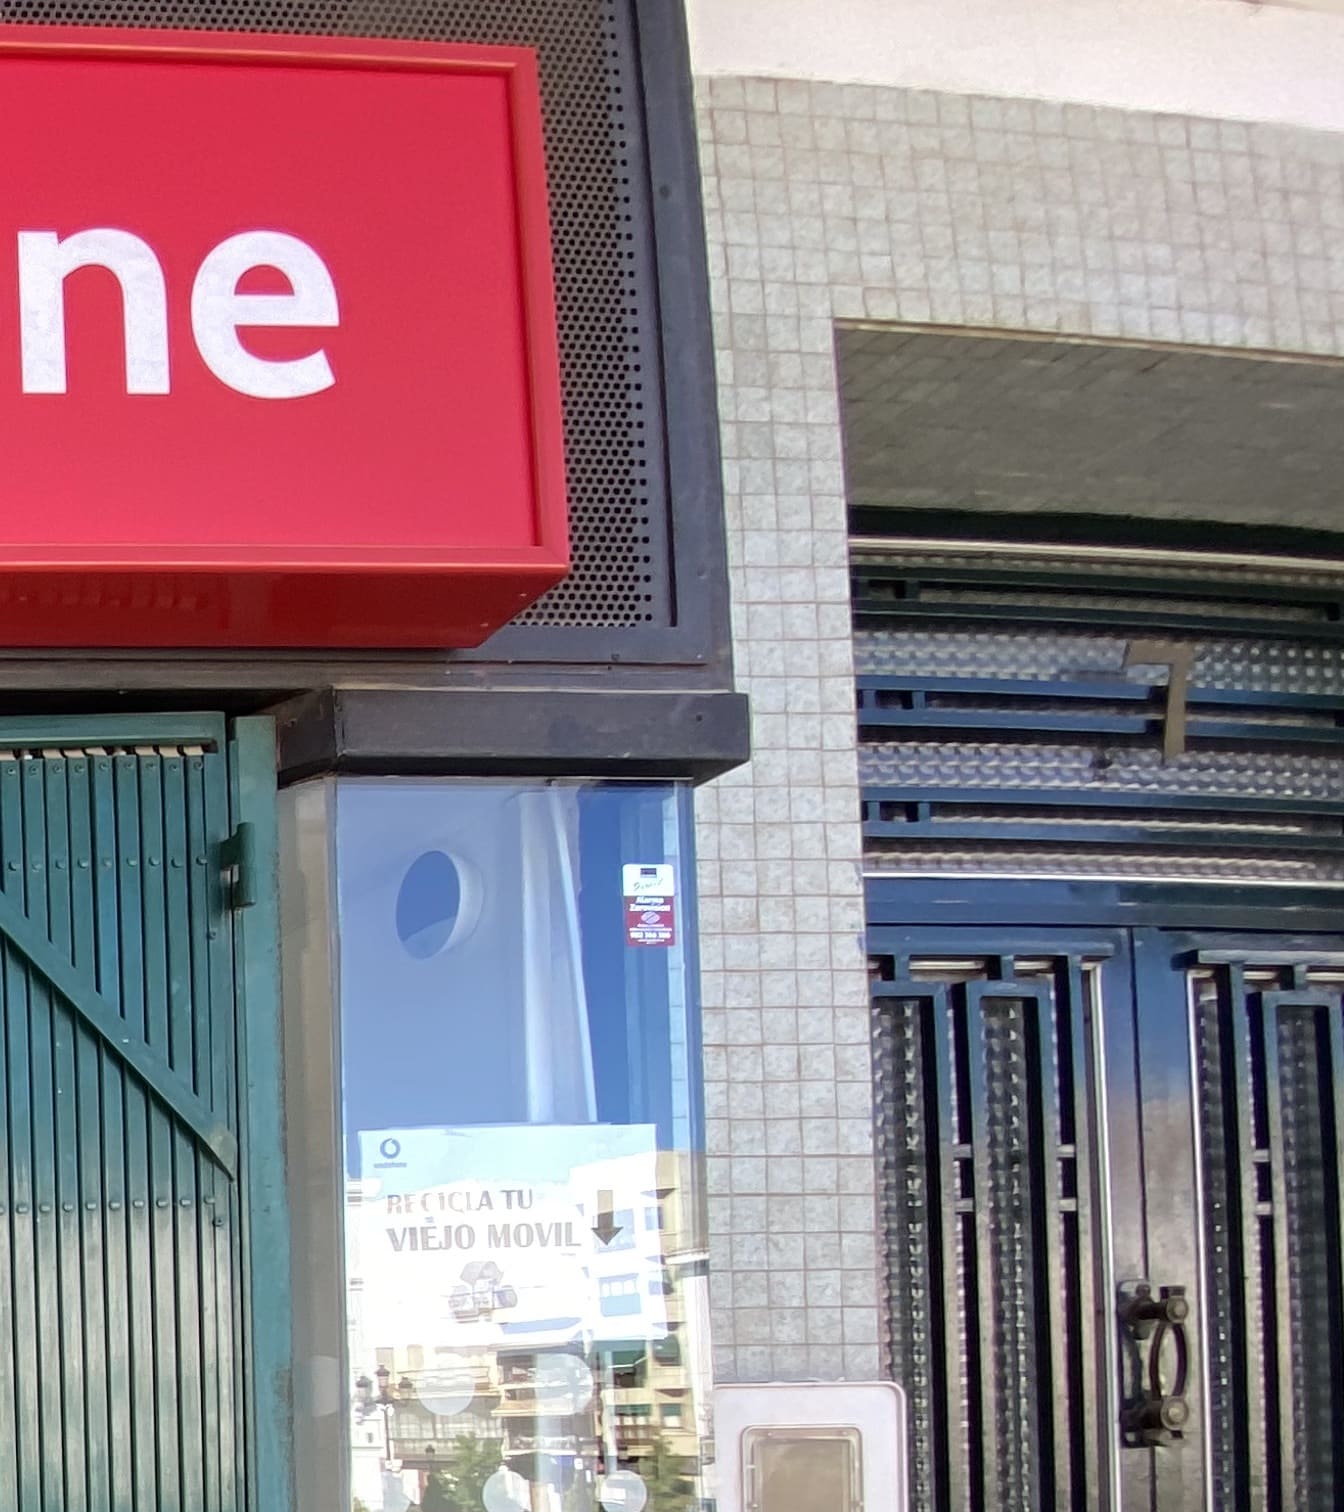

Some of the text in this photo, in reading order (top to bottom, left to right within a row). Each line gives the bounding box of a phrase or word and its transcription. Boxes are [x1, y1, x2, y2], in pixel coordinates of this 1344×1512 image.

[387, 1189, 533, 1214] RECICLA TU
[488, 1221, 581, 1248] MOVIL
